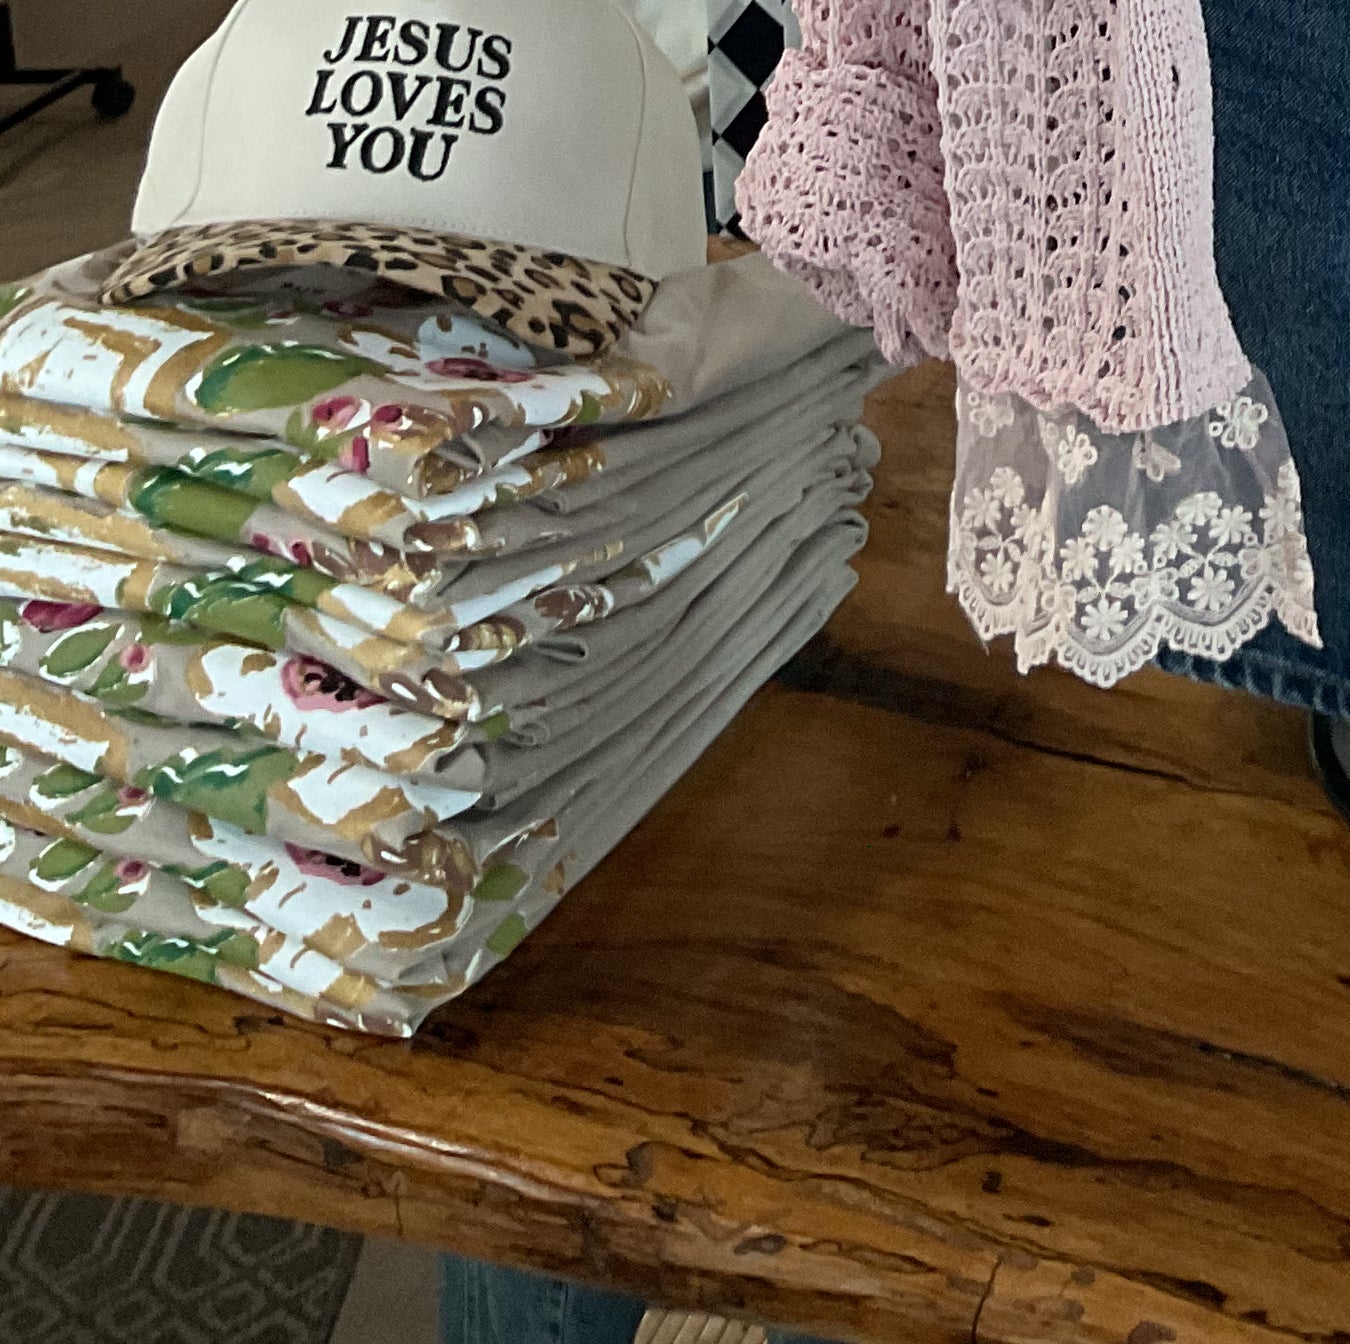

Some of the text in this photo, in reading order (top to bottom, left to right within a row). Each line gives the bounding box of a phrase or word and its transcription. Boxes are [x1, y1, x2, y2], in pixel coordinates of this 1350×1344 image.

[323, 14, 513, 80] JESUS
[305, 69, 506, 135] LOVES
[326, 122, 458, 182] YOU
